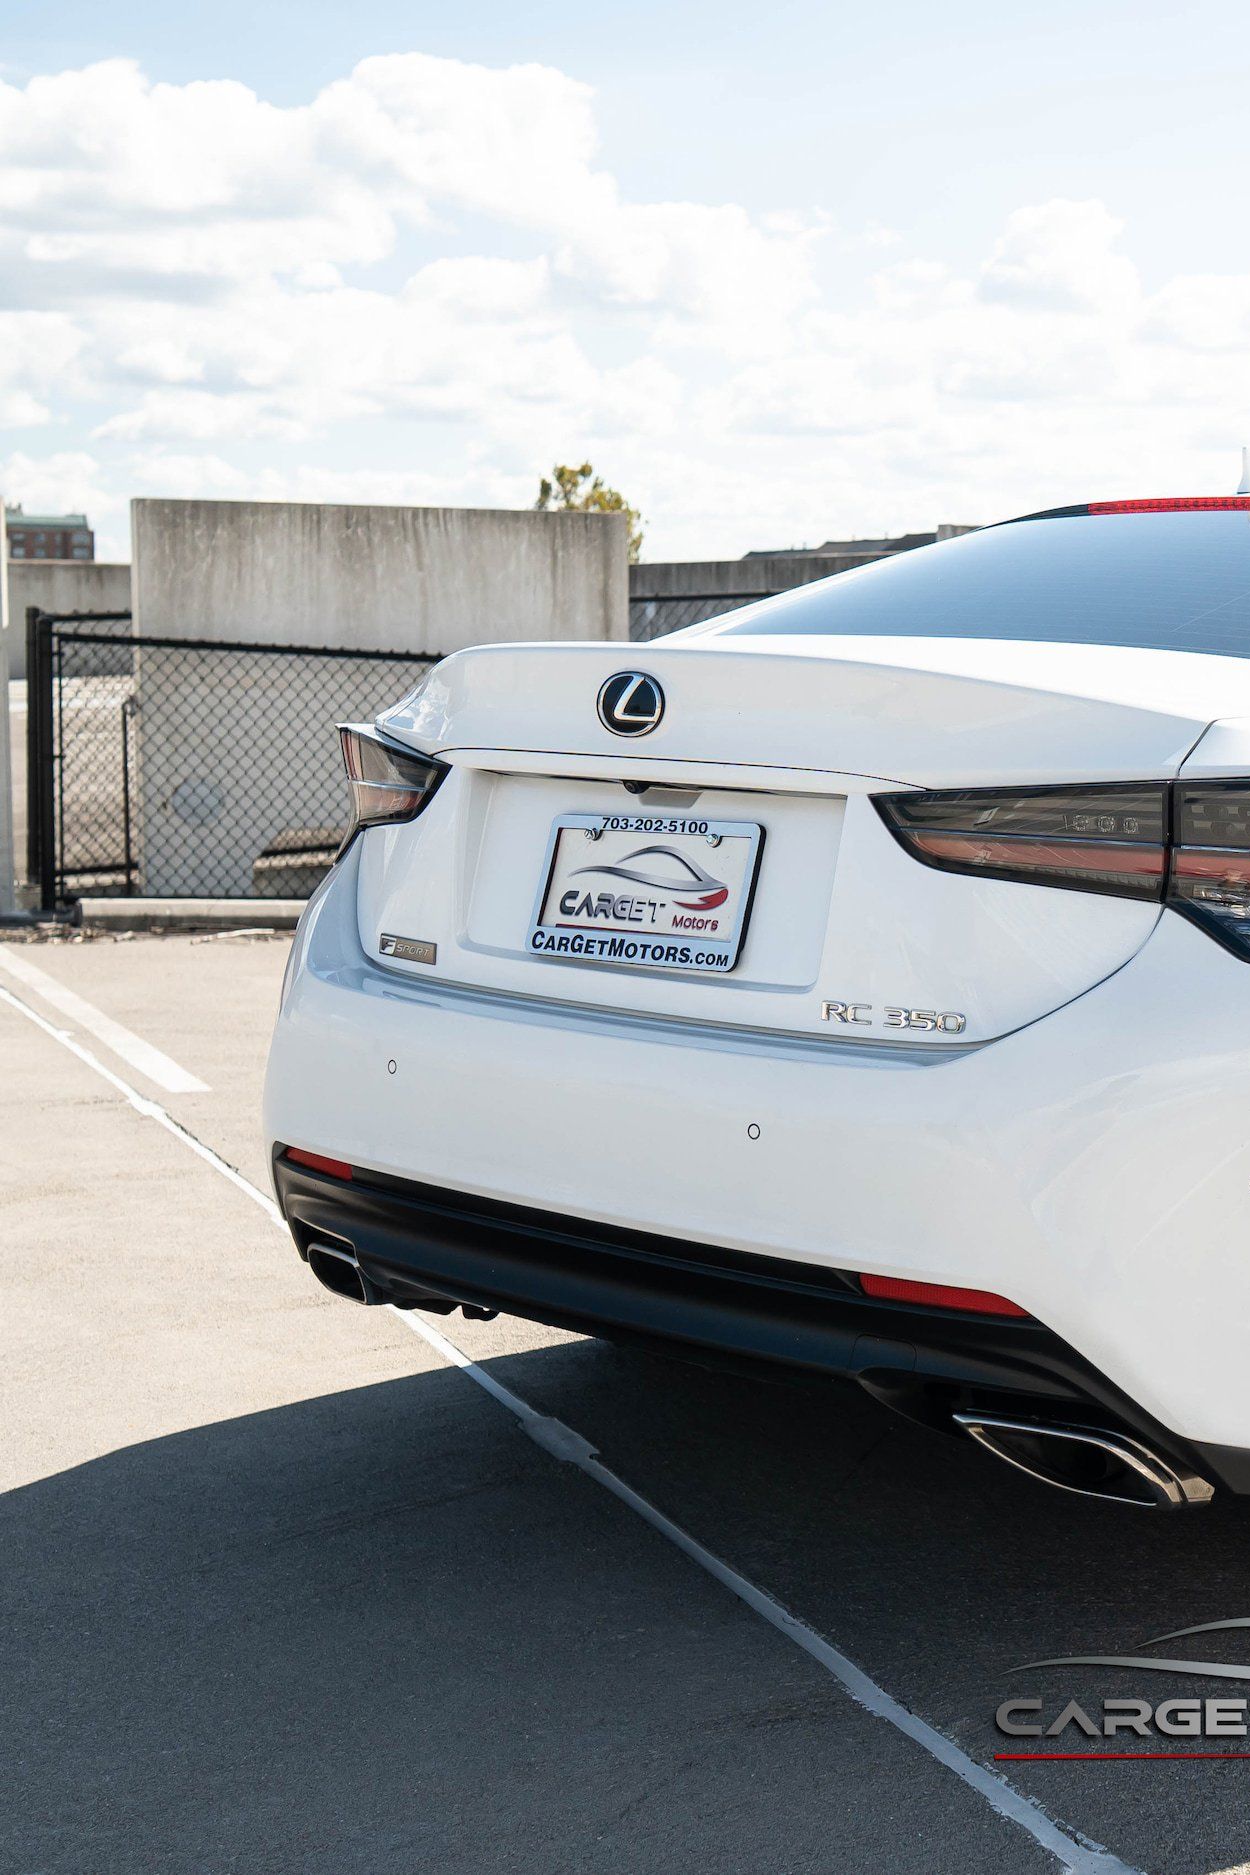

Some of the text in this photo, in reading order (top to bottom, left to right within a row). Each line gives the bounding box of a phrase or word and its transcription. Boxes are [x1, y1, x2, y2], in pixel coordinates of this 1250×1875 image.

[601, 816, 709, 835] 703-202-5100
[559, 890, 719, 932] CARGET Motors
[396, 943, 430, 956] SPORT
[820, 999, 967, 1035] RC 350
